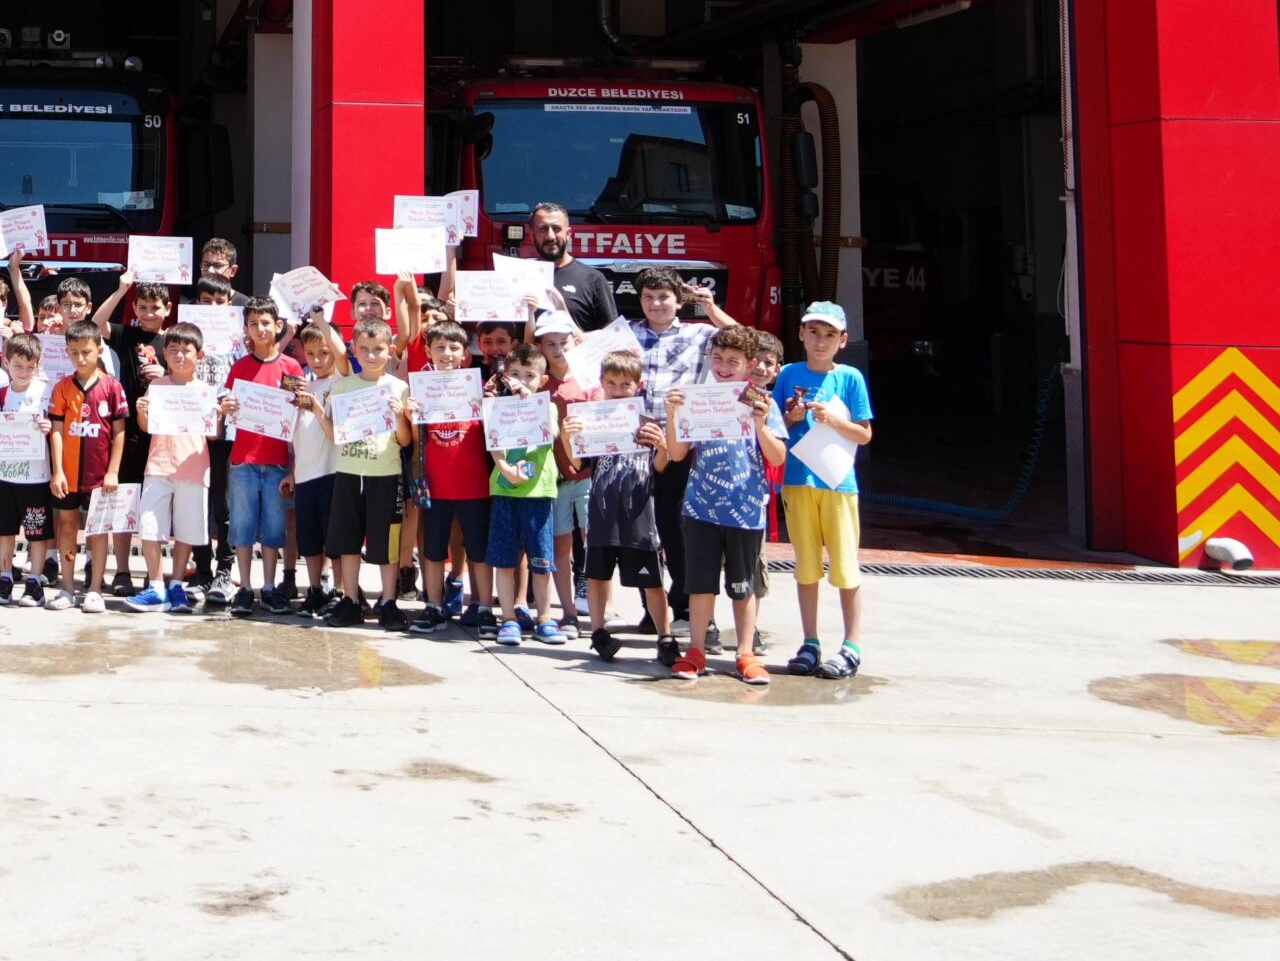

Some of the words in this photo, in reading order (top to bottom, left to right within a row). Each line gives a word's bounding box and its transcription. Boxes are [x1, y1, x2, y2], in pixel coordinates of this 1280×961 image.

[9, 103, 113, 114] BELEDİYESİ
[144, 114, 162, 128] 50
[736, 113, 750, 124] 51
[905, 266, 926, 292] 44
[68, 421, 101, 438] SIXT
